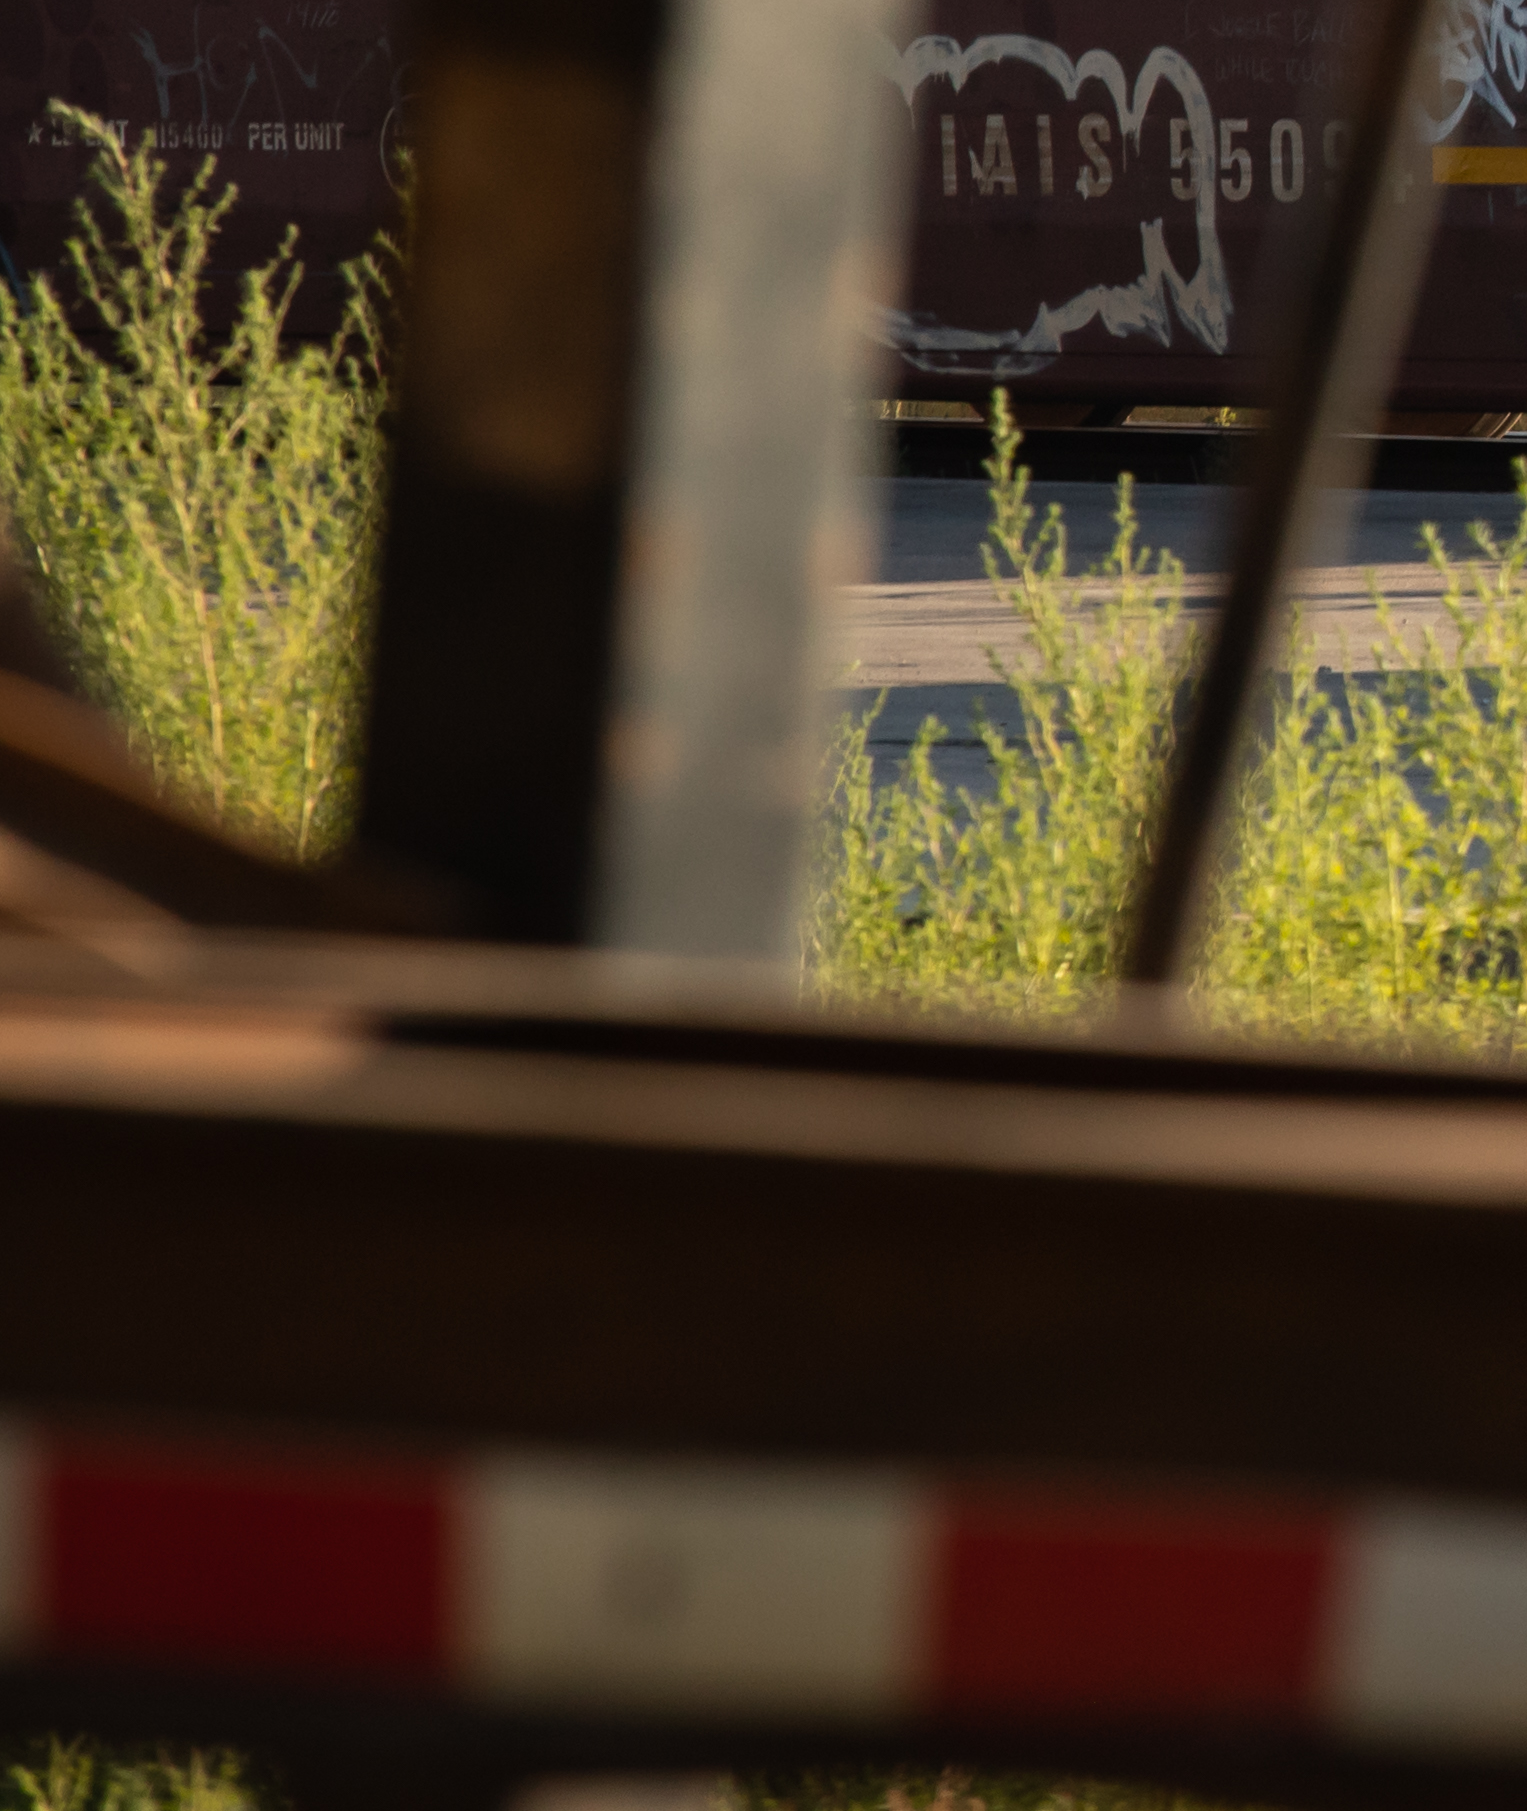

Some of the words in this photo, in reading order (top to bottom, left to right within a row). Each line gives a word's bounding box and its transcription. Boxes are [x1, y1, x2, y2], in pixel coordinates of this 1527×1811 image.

[248, 121, 288, 152] PER
[294, 121, 345, 152] UNIT
[940, 113, 1115, 198] IAIS
